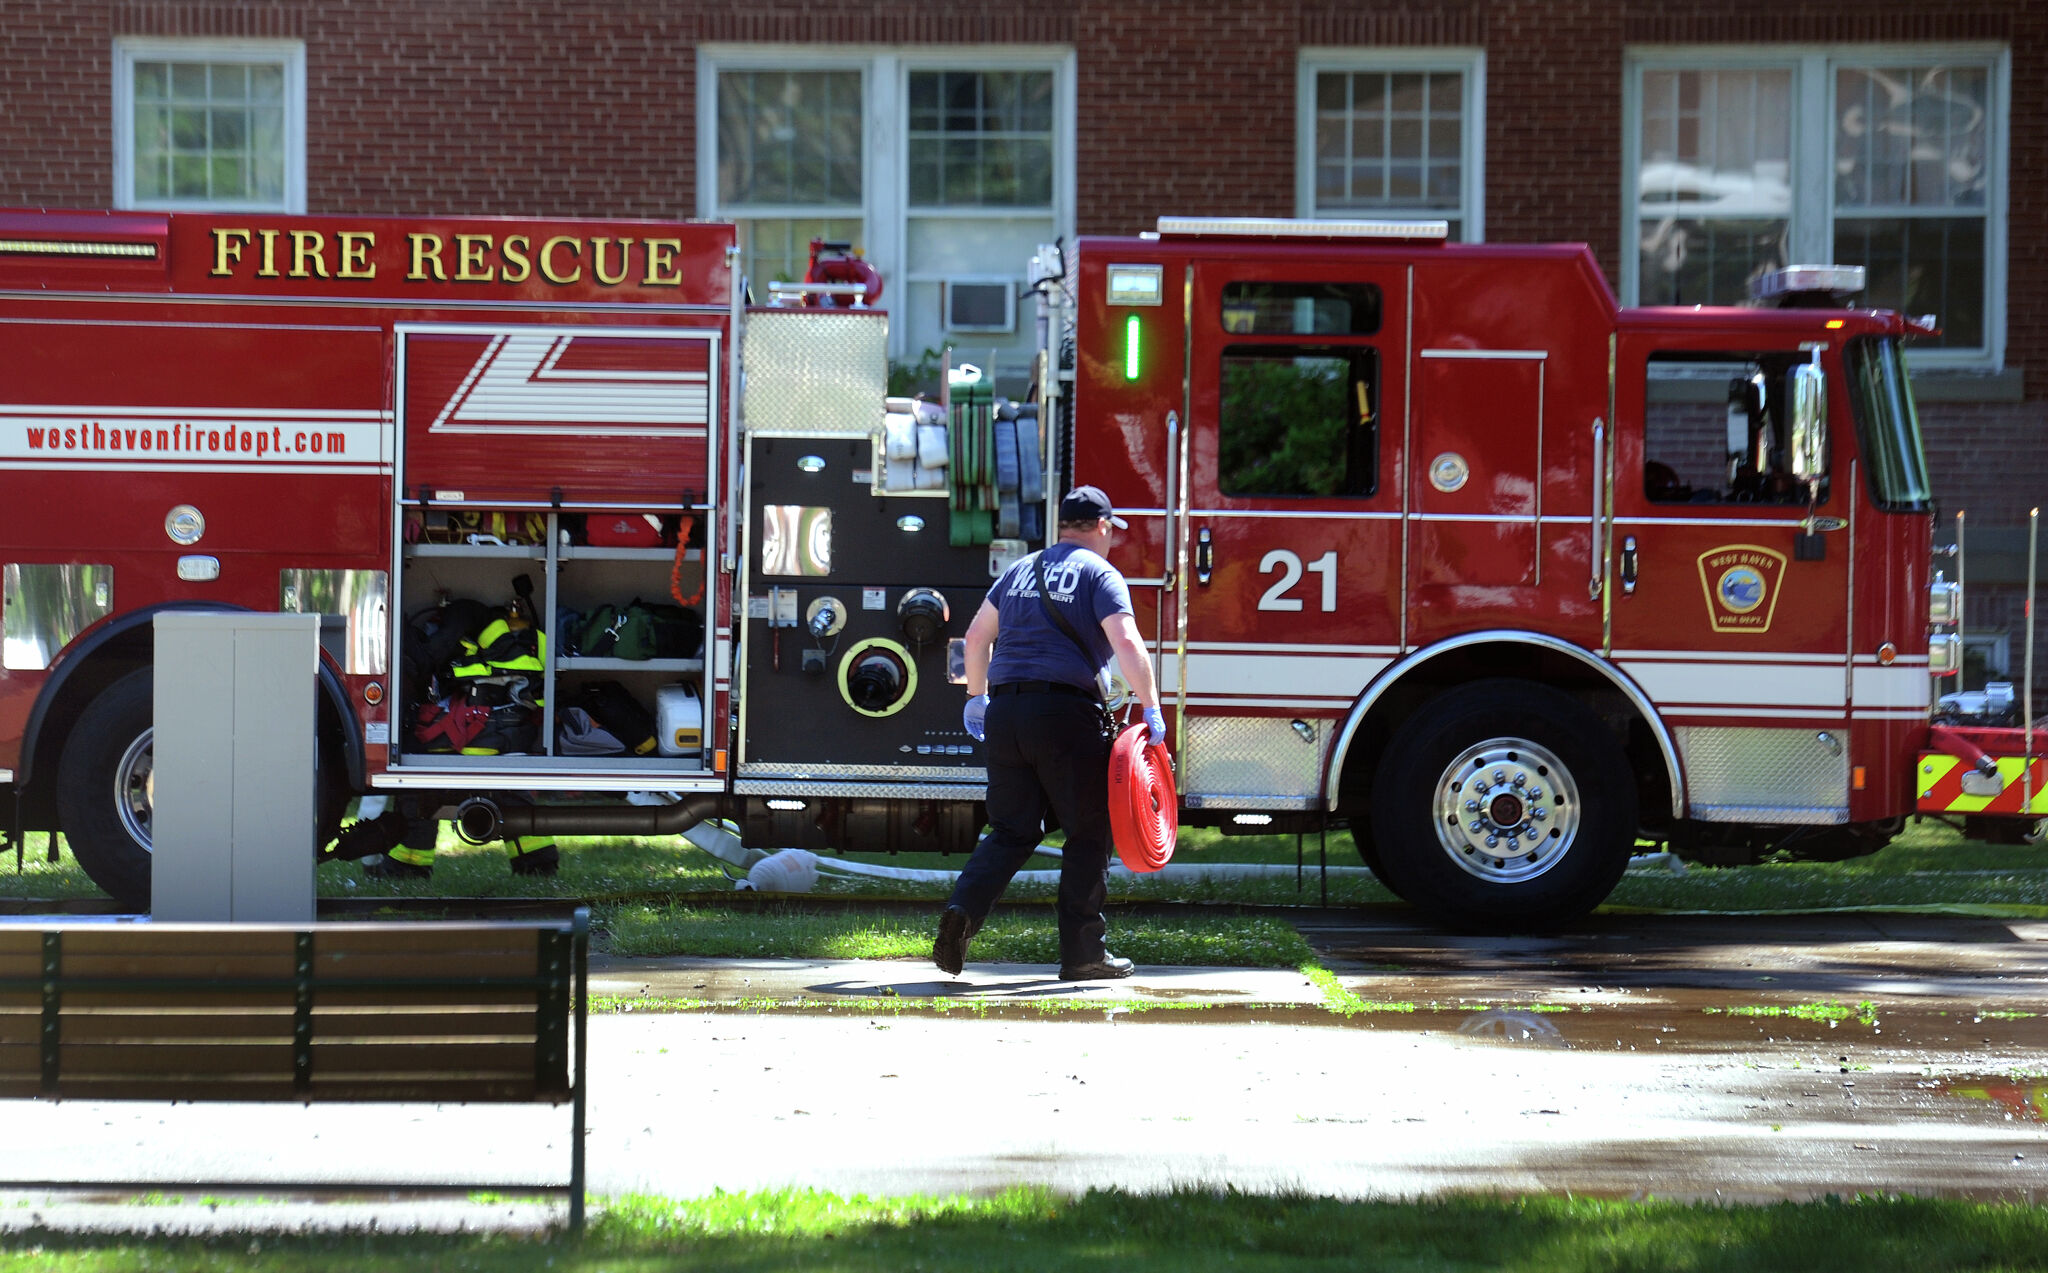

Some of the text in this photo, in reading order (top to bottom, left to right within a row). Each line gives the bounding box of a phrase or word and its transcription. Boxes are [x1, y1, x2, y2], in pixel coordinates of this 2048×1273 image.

[210, 228, 684, 289] FIRE RESCUE
[26, 421, 345, 458] westhavenfiredept.com
[1257, 549, 1338, 612] 21
